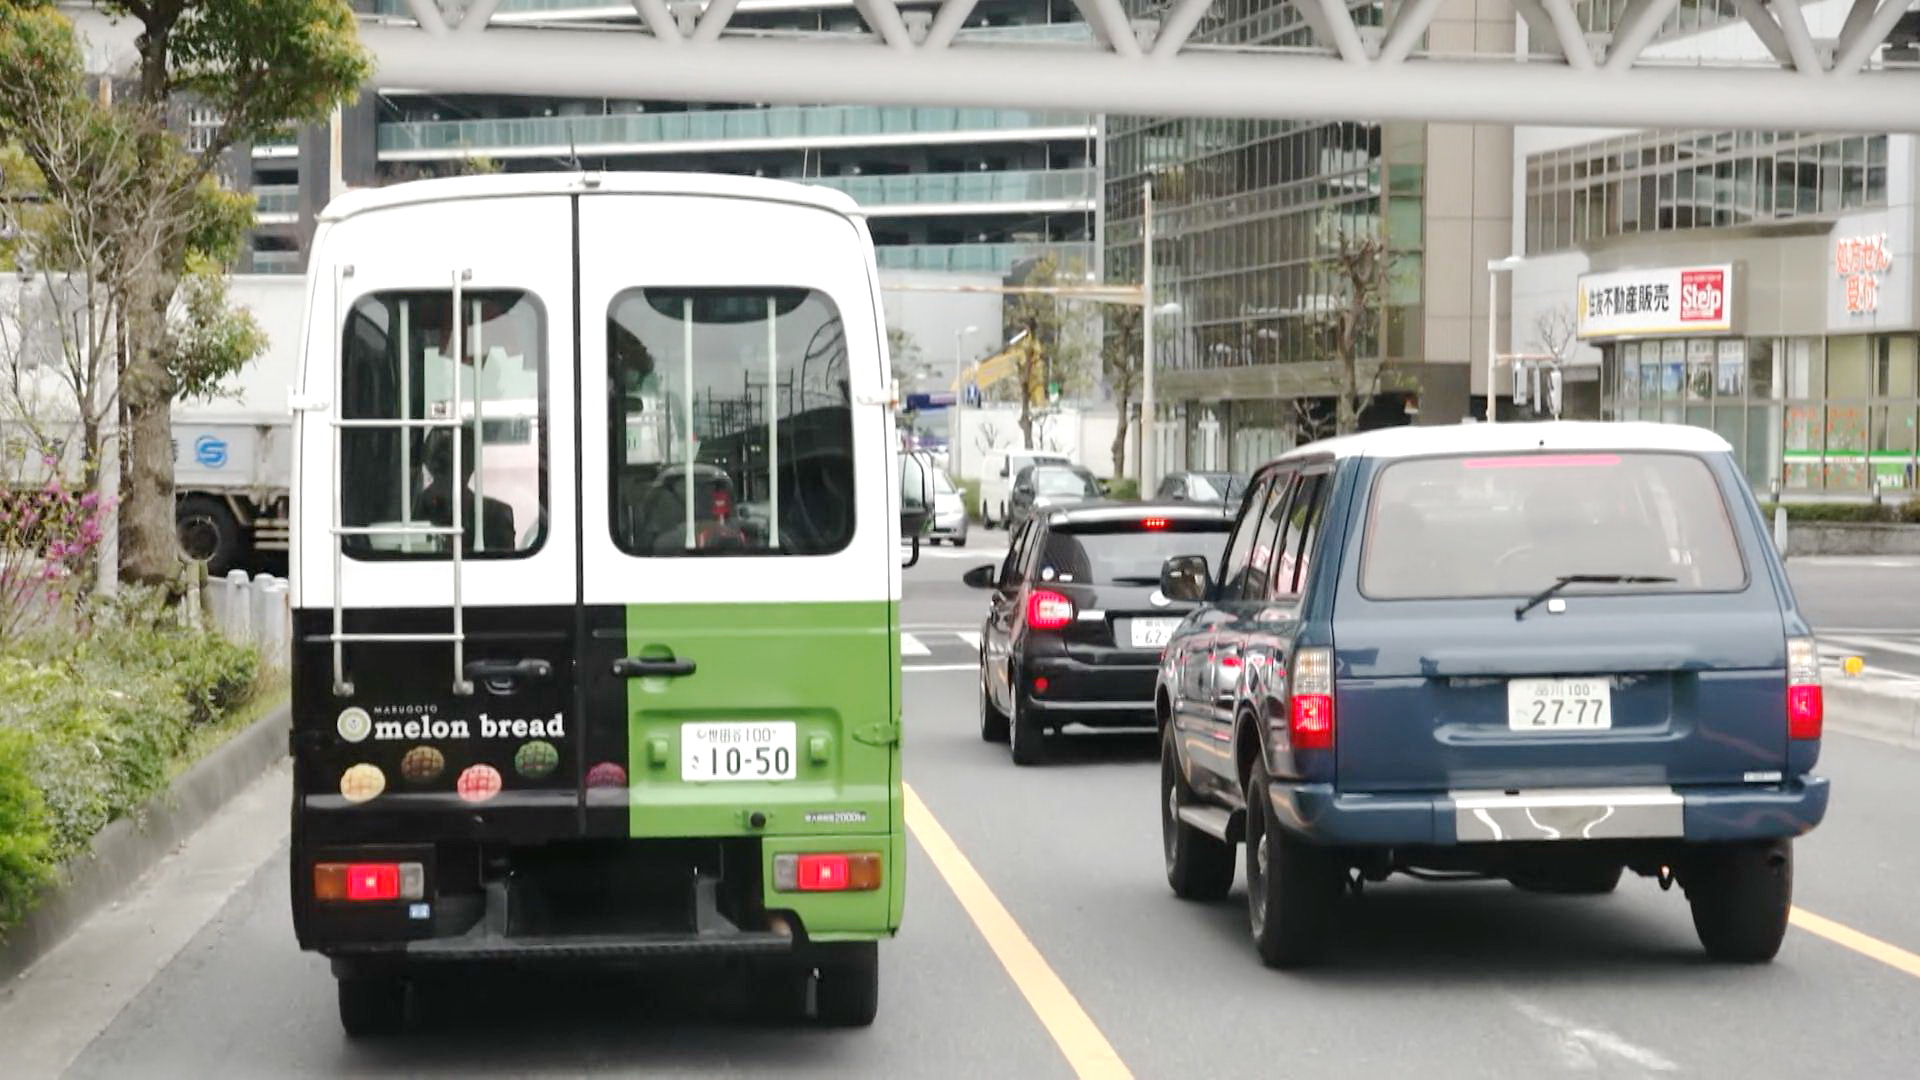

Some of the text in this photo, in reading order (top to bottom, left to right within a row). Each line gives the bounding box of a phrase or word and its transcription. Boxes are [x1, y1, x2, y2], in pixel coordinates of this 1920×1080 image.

[1589, 284, 1670, 318] 住友不動産販売
[1845, 274, 1879, 313] 受付
[374, 704, 438, 714] MARUGOTO
[1532, 699, 1603, 726] 27-77
[374, 713, 565, 740] melon bread
[712, 746, 789, 776] 10-50
